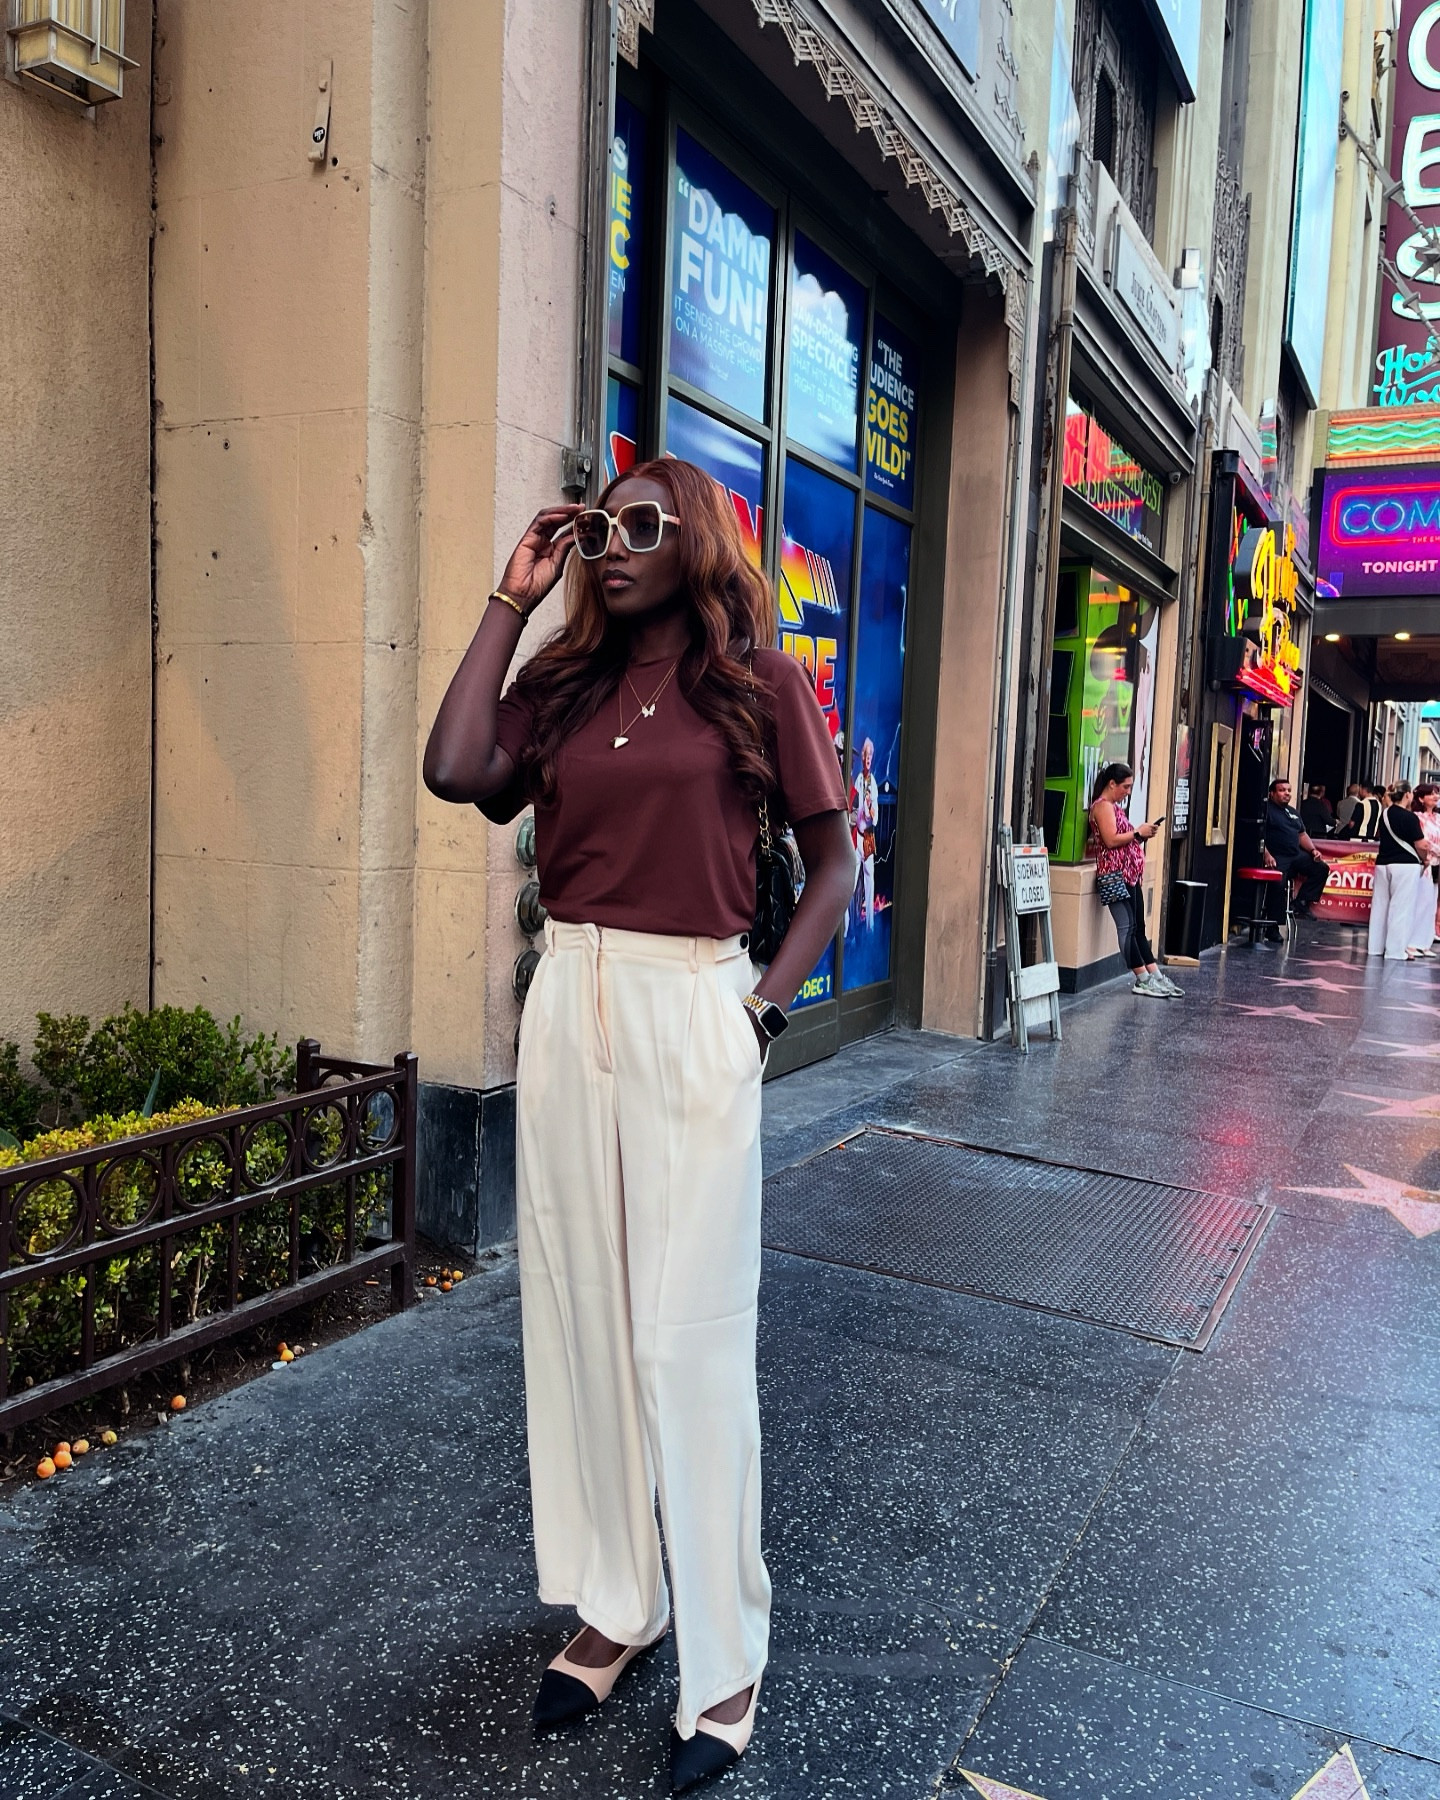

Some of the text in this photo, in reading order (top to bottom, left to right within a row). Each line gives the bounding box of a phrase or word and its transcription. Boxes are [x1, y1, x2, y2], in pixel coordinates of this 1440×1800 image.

[680, 231, 763, 342] FUN!
[674, 294, 762, 362] IT SENDS THE CROWD
[675, 316, 690, 337] ON
[691, 326, 699, 342] A
[700, 330, 736, 365] MASSIVE
[791, 302, 859, 362] JAW-DROPPING
[791, 324, 858, 389] SPECTACLE
[869, 360, 914, 412] UDIENCE
[867, 388, 908, 443] GOES
[1362, 559, 1438, 574] TONIGHT
[1016, 862, 1046, 880] SIDEWALK
[1021, 885, 1045, 904] CLOSED
[826, 974, 831, 993] 1
